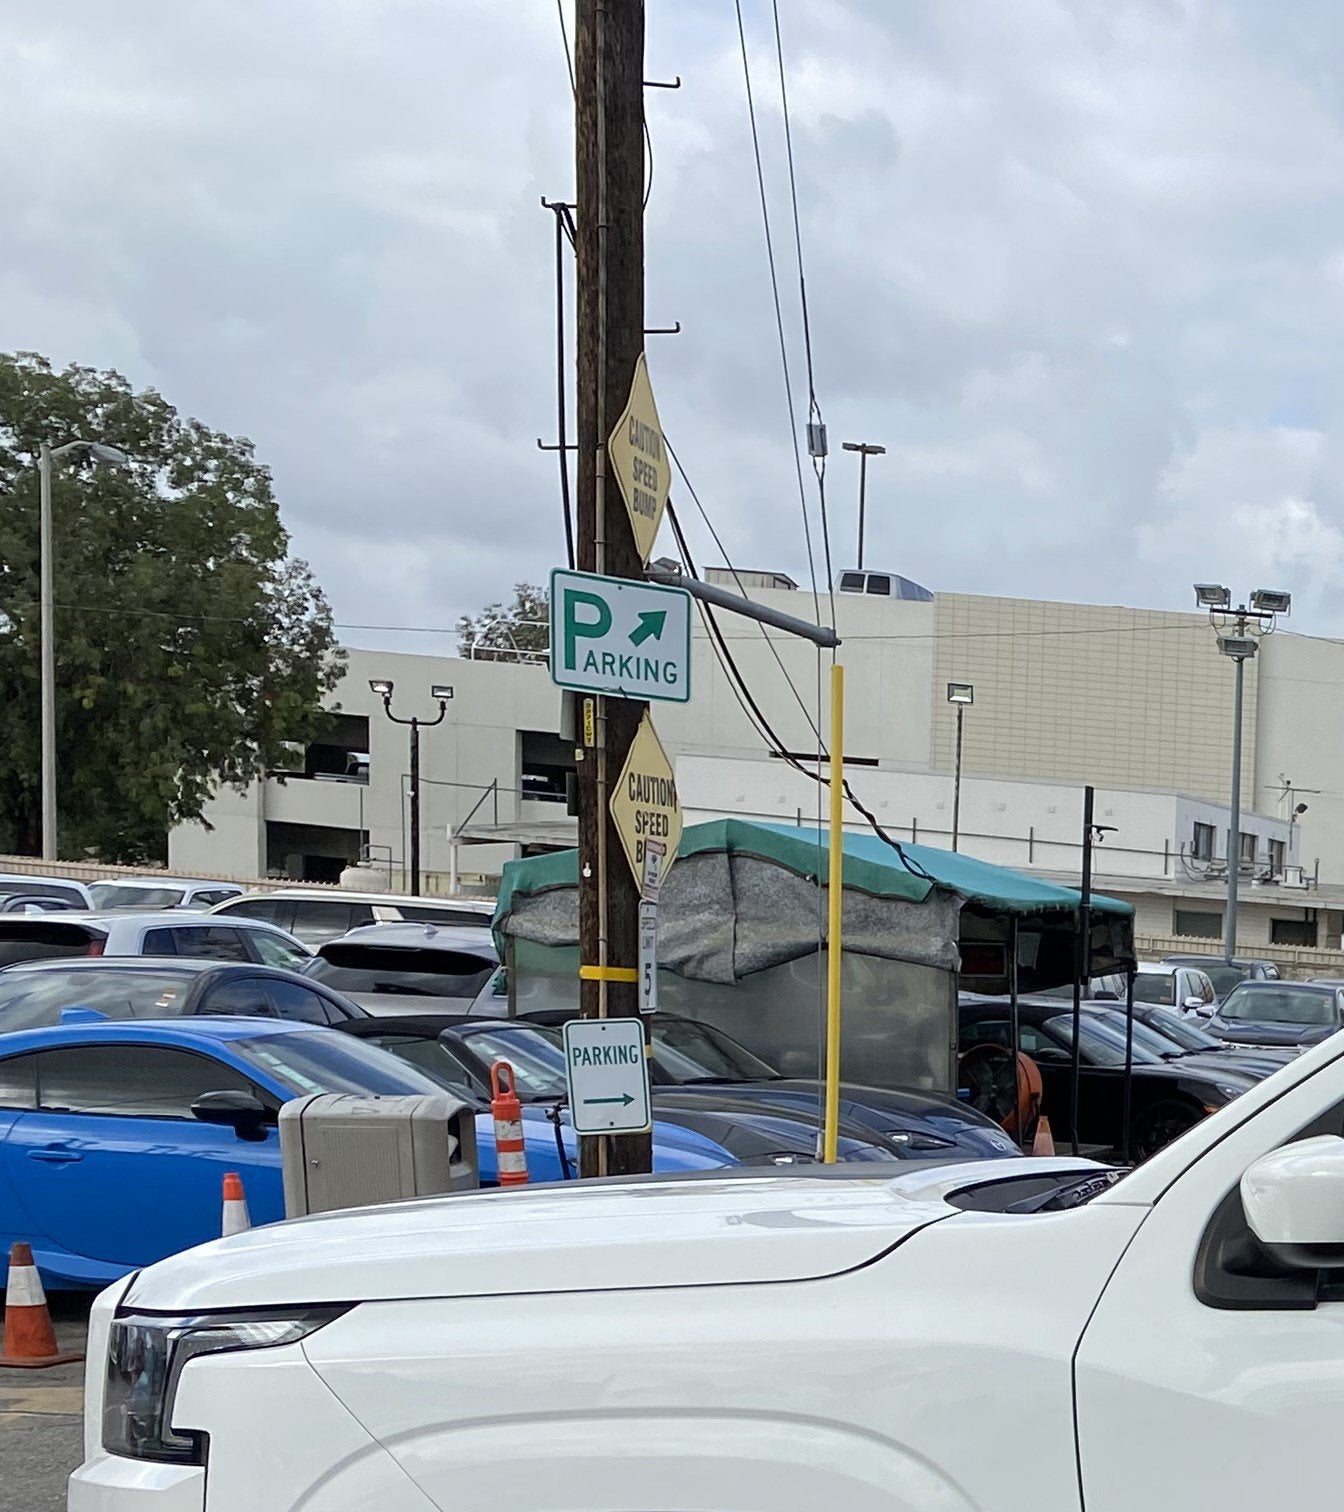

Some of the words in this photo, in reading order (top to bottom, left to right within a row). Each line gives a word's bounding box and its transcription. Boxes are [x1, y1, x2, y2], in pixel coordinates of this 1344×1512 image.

[632, 455, 657, 492] SPEED
[563, 587, 678, 685] PARKING
[628, 771, 675, 808] CAUTION
[634, 808, 669, 838] SPEED
[572, 1044, 639, 1067] PARKING
